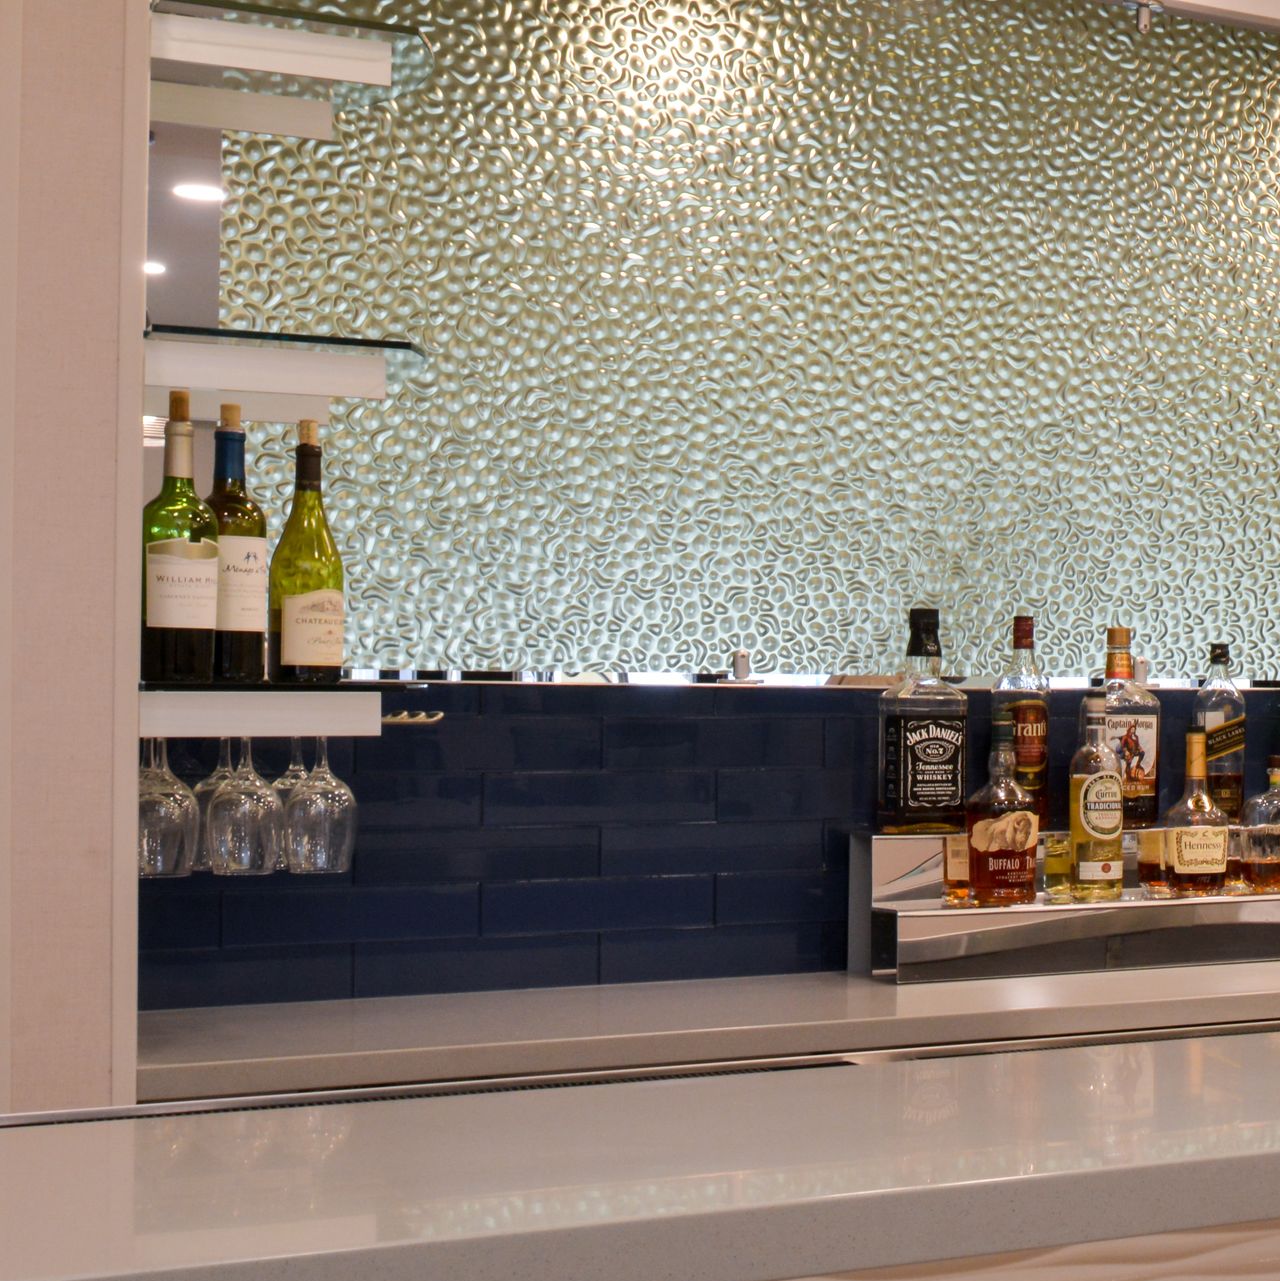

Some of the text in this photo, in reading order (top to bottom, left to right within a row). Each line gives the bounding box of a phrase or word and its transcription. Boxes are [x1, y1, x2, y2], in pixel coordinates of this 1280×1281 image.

[156, 575, 202, 584] WILLIAM
[1107, 719, 1132, 730] Captain
[906, 728, 929, 746] JACK
[1208, 734, 1227, 745] BLACK
[915, 761, 954, 771] Tennessee
[1184, 839, 1222, 851] Hennessy
[989, 857, 1020, 871] BUFFALO
